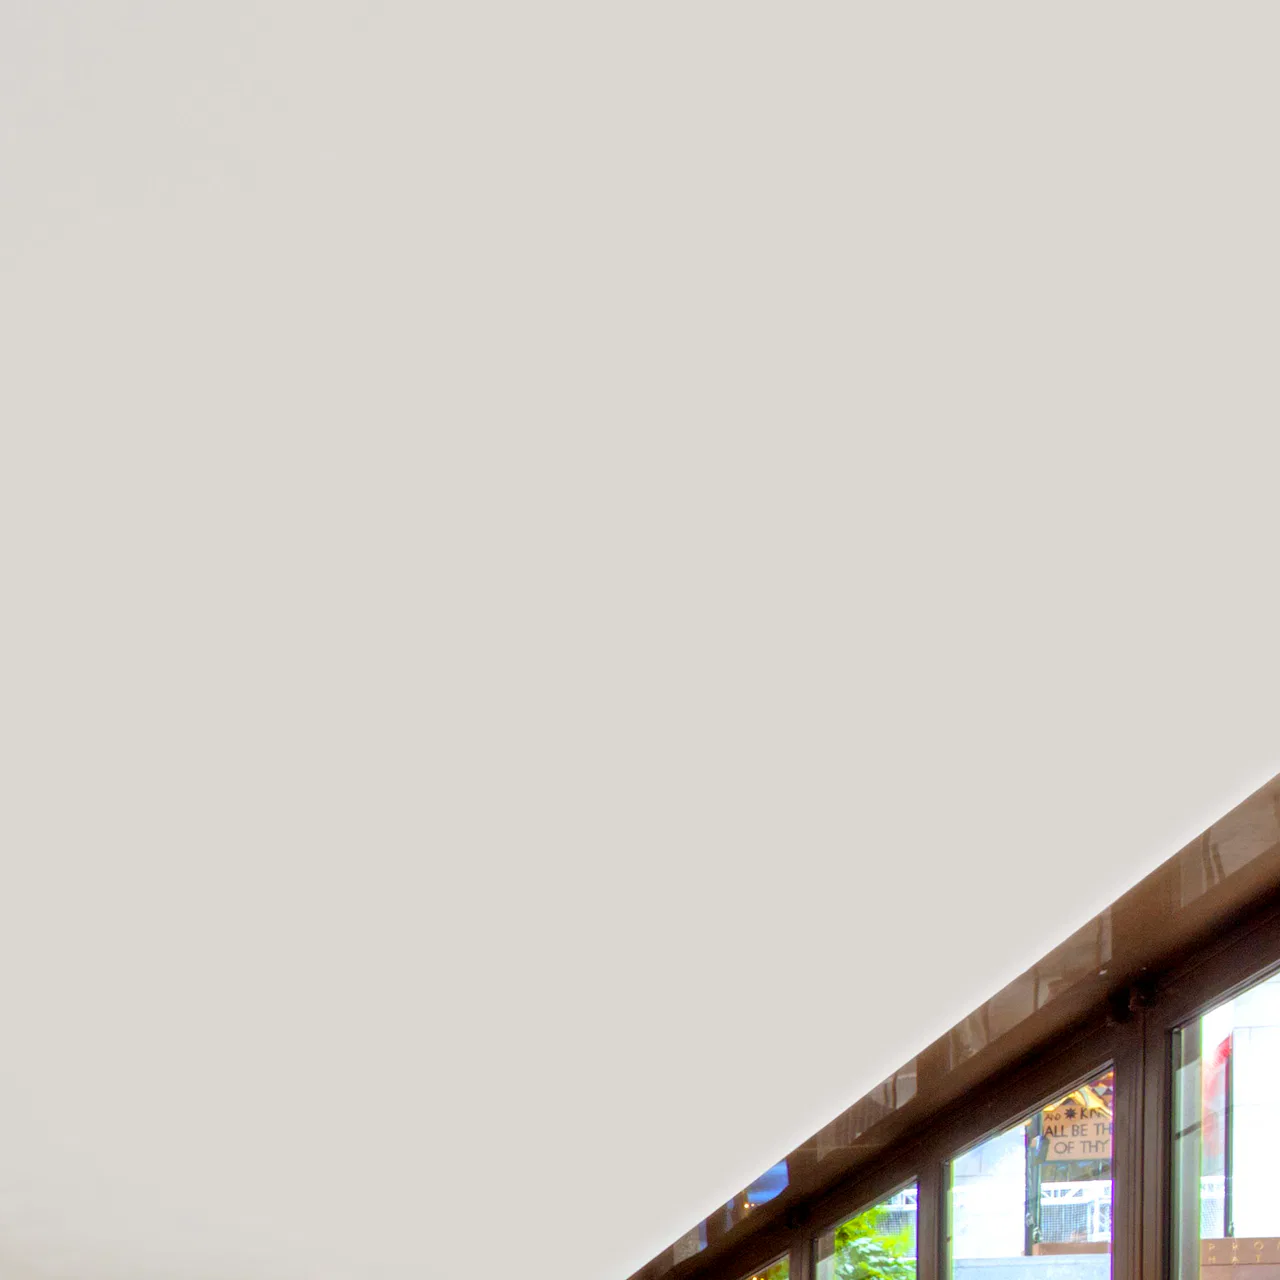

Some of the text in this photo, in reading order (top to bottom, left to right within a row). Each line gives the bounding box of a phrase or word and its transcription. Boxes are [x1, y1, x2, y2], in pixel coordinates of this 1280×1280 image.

[1072, 1124, 1088, 1136] BE
[1054, 1139, 1109, 1154] OF THY
